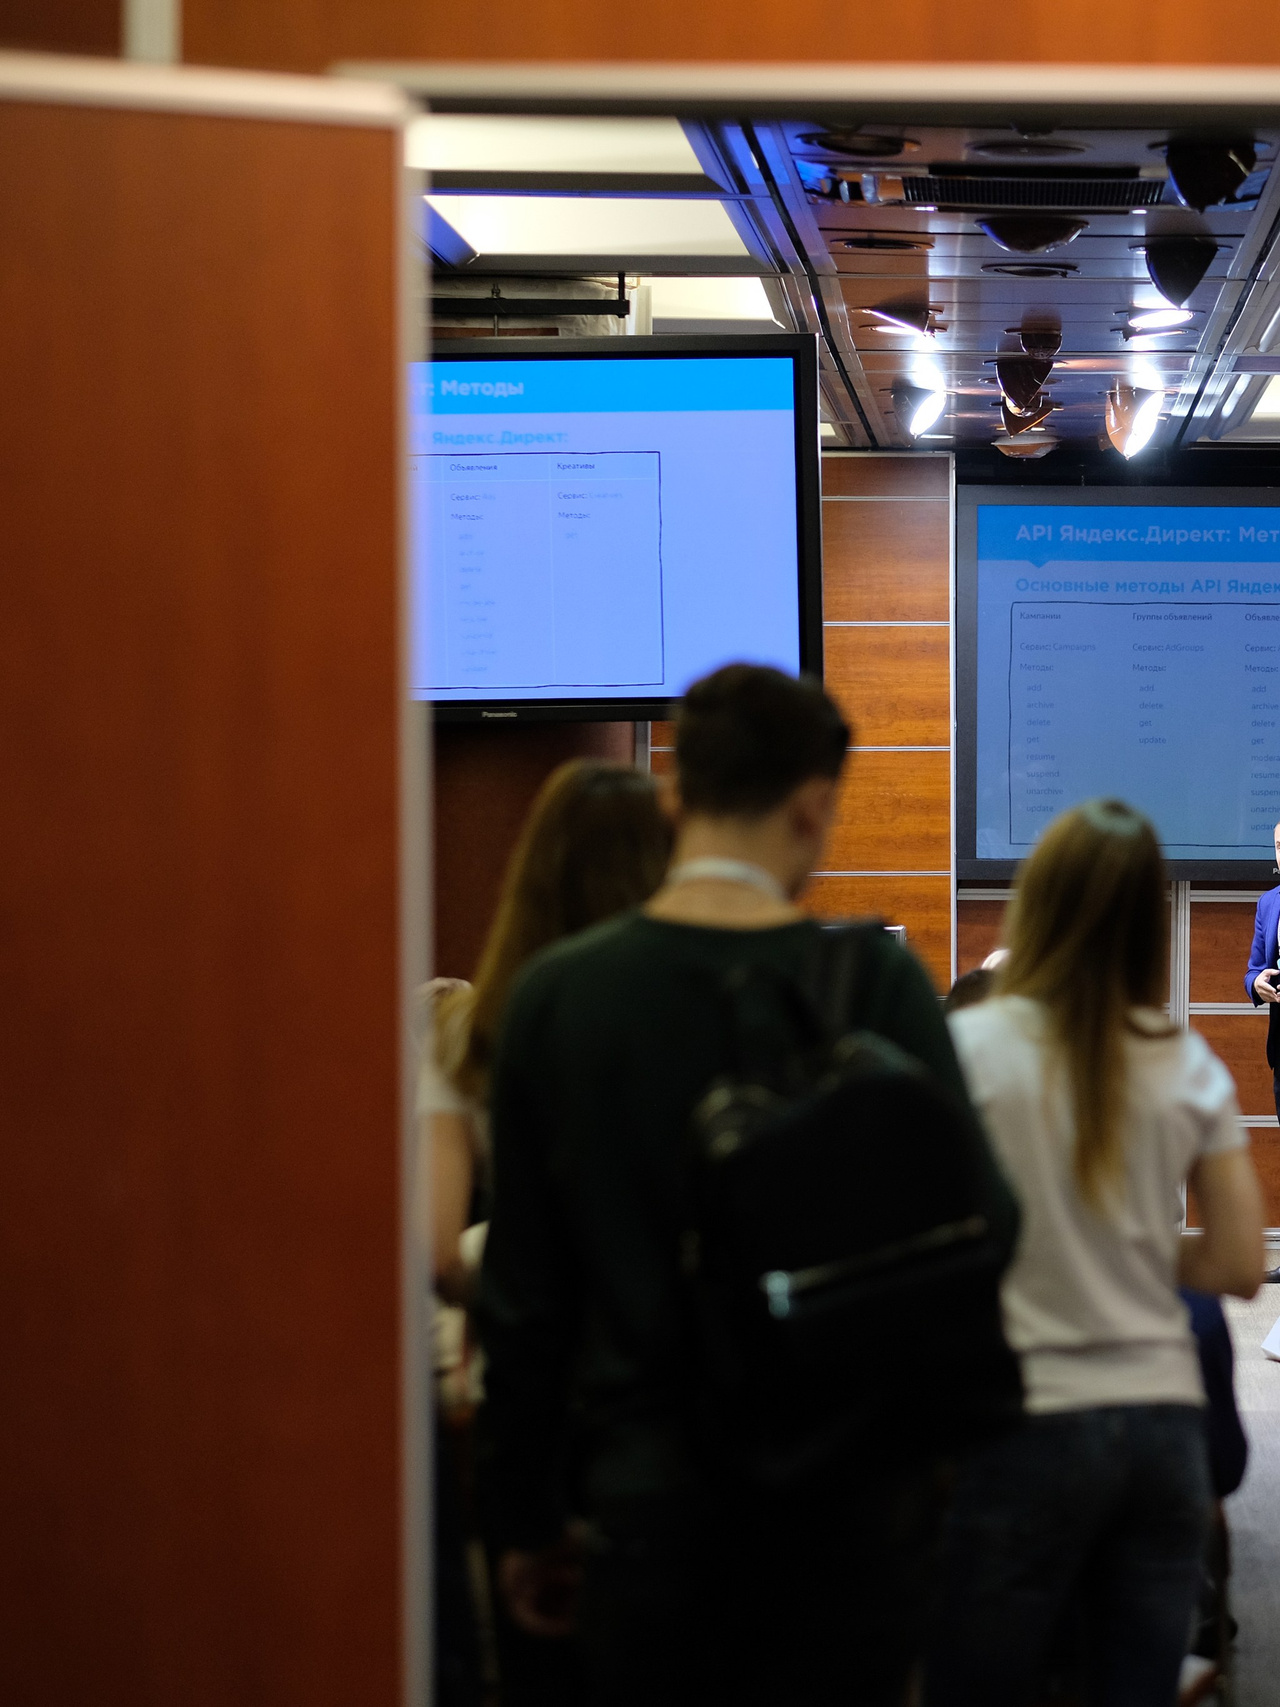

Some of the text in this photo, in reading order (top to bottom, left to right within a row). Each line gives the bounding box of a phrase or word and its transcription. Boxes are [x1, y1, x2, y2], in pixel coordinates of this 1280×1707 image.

[441, 380, 524, 398] Методы
[450, 463, 498, 472] Объявления
[557, 462, 596, 471] Креативы
[1016, 524, 1052, 542] API
[1060, 524, 1231, 545] Яндекс.Директ:
[1016, 577, 1109, 593] Основные
[1115, 578, 1185, 596] методы
[1191, 579, 1221, 594] API
[1020, 612, 1062, 621] Кампании
[1132, 612, 1213, 622] Группы объявлений
[1019, 642, 1096, 652] Сервис: Campaigns
[1132, 643, 1204, 652] Сервис: AdGroups
[1244, 644, 1277, 653] Сервис:
[1019, 663, 1054, 672] Методы:
[1132, 663, 1167, 673] Методы:
[1244, 664, 1279, 673] Методы:
[1138, 719, 1153, 727] get
[1138, 736, 1167, 744] update
[1250, 737, 1264, 745] get
[1026, 770, 1060, 778] suspend
[1026, 805, 1054, 813] update
